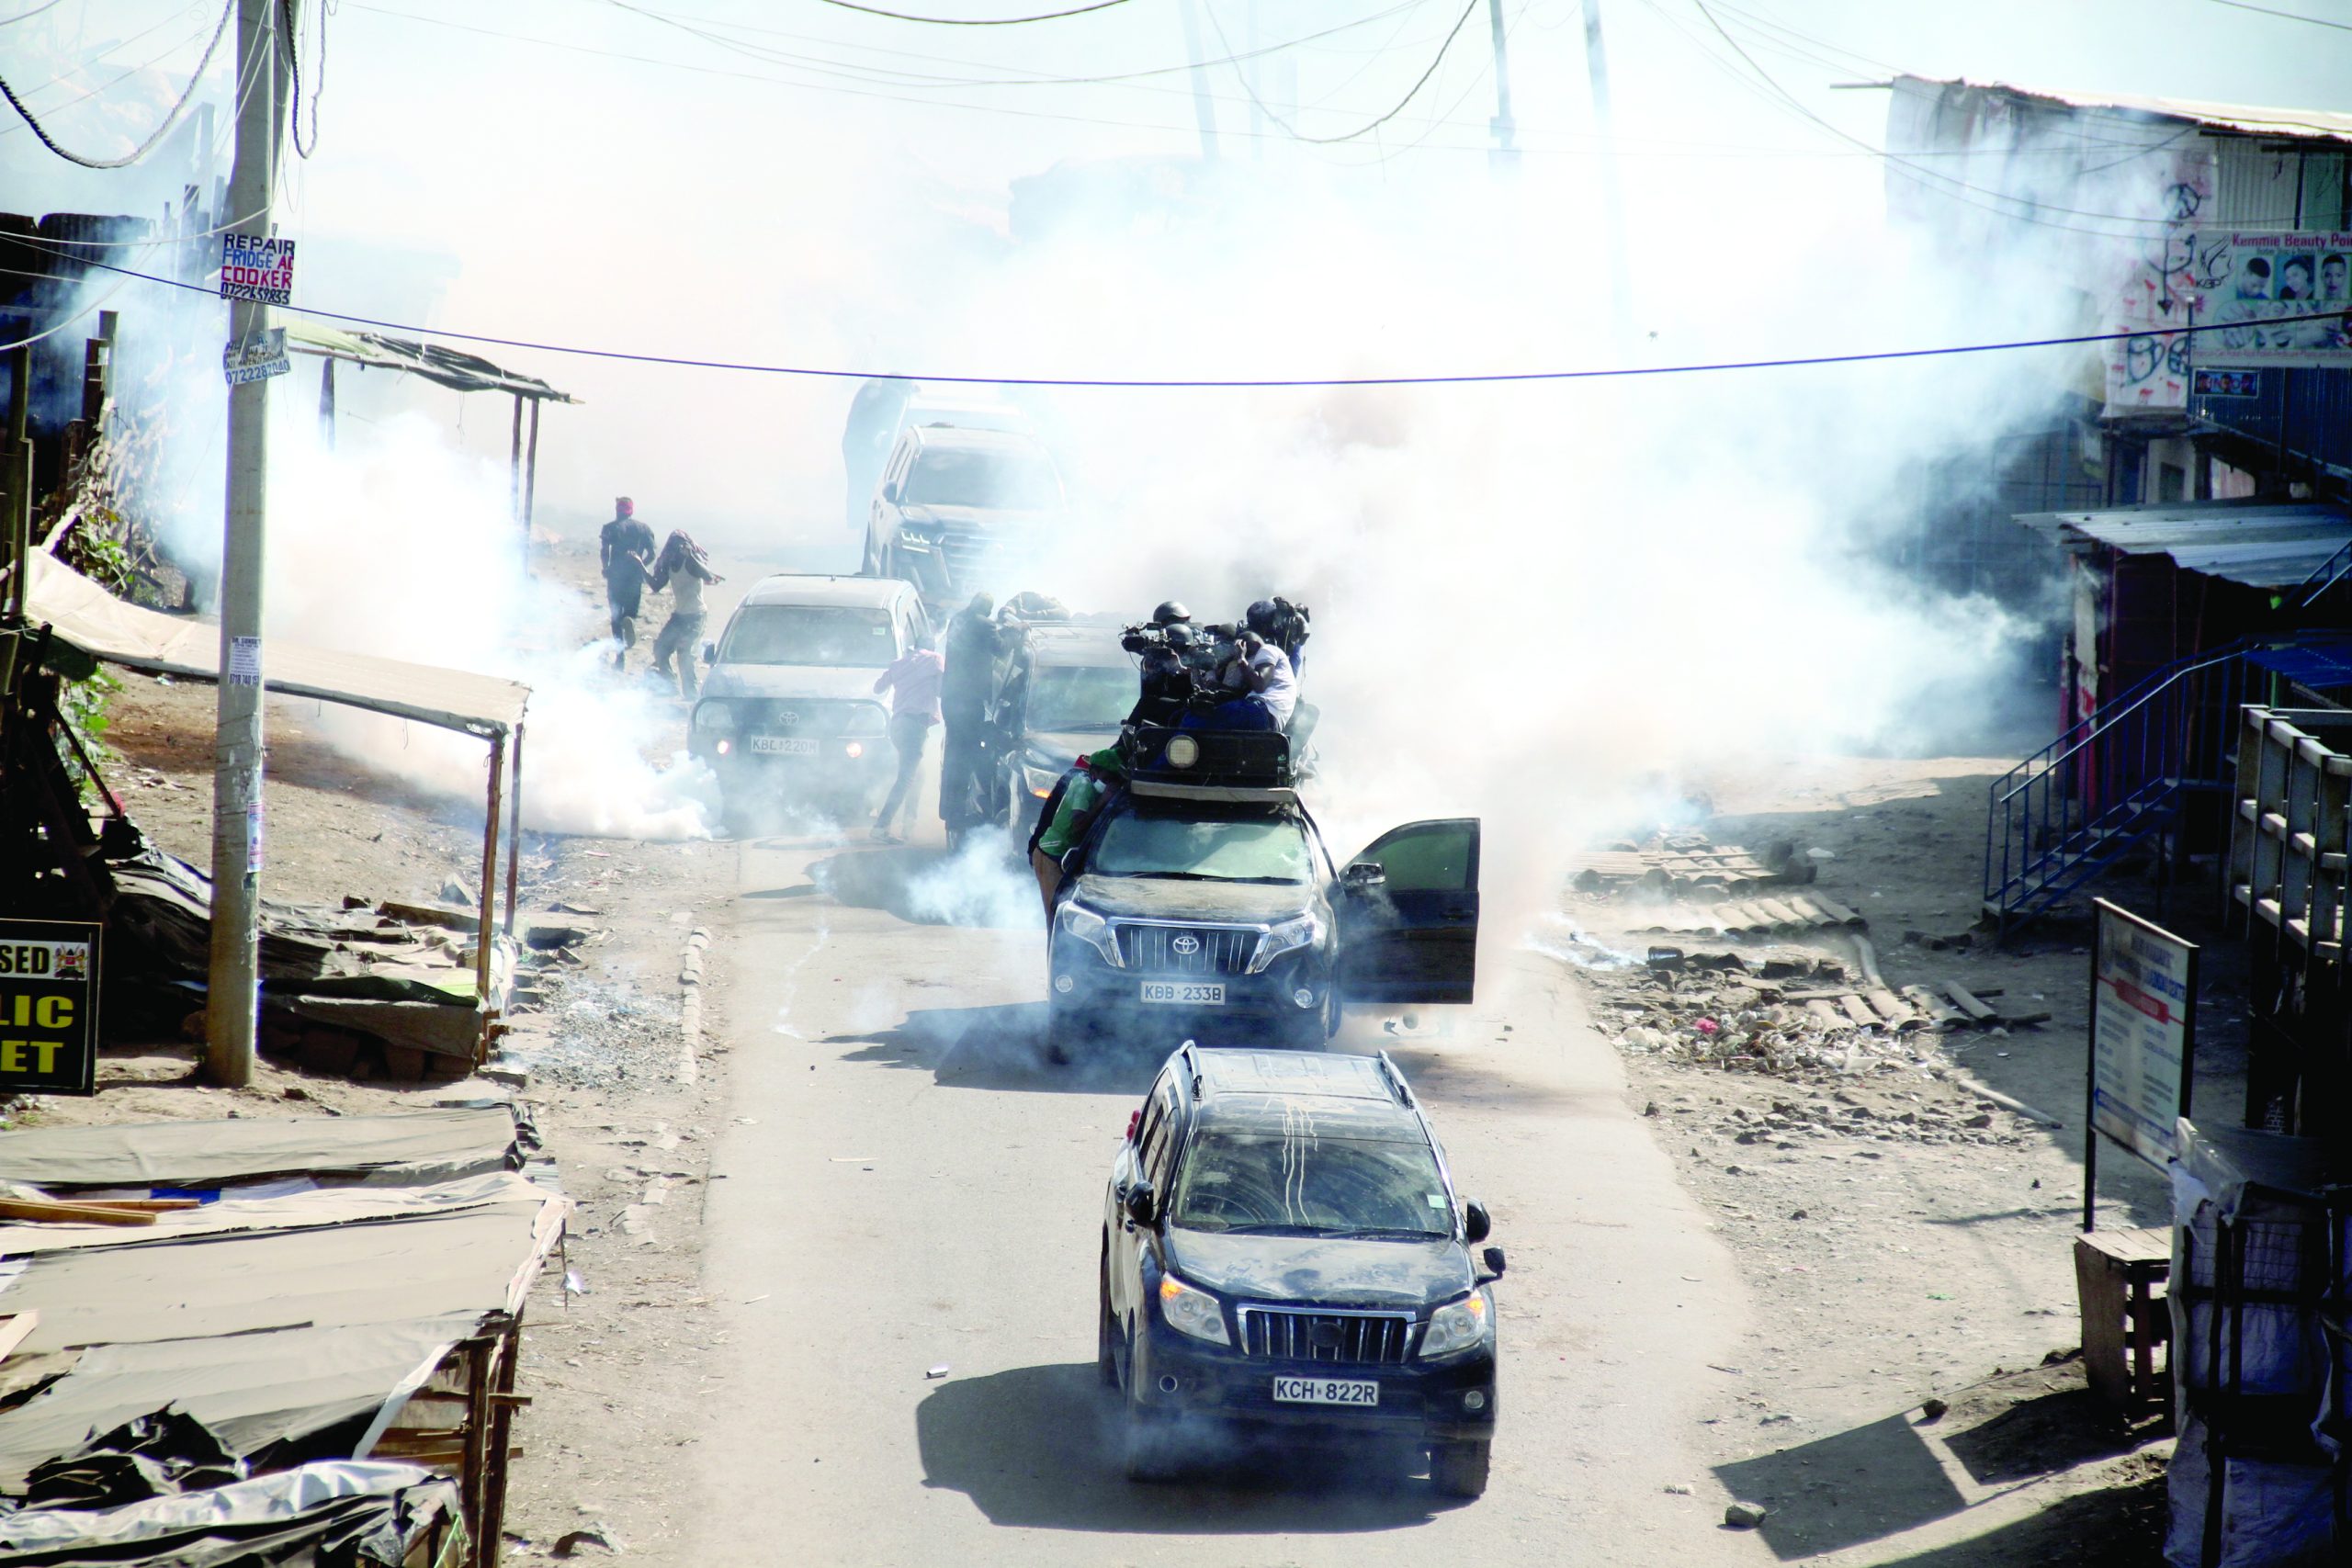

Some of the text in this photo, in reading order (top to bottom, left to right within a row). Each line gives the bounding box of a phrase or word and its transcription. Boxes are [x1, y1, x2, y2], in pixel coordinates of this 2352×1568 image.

[224, 233, 295, 256] REPAIR
[2285, 233, 2326, 248] Beauty
[222, 248, 273, 268] FRIDGE
[221, 265, 293, 289] COOKER
[225, 359, 290, 384] 0722282040
[0, 945, 50, 975] SED
[1145, 985, 1222, 1001] KBB 233B
[1, 1040, 64, 1073] ET
[1275, 1381, 1376, 1404] KCH 822R
